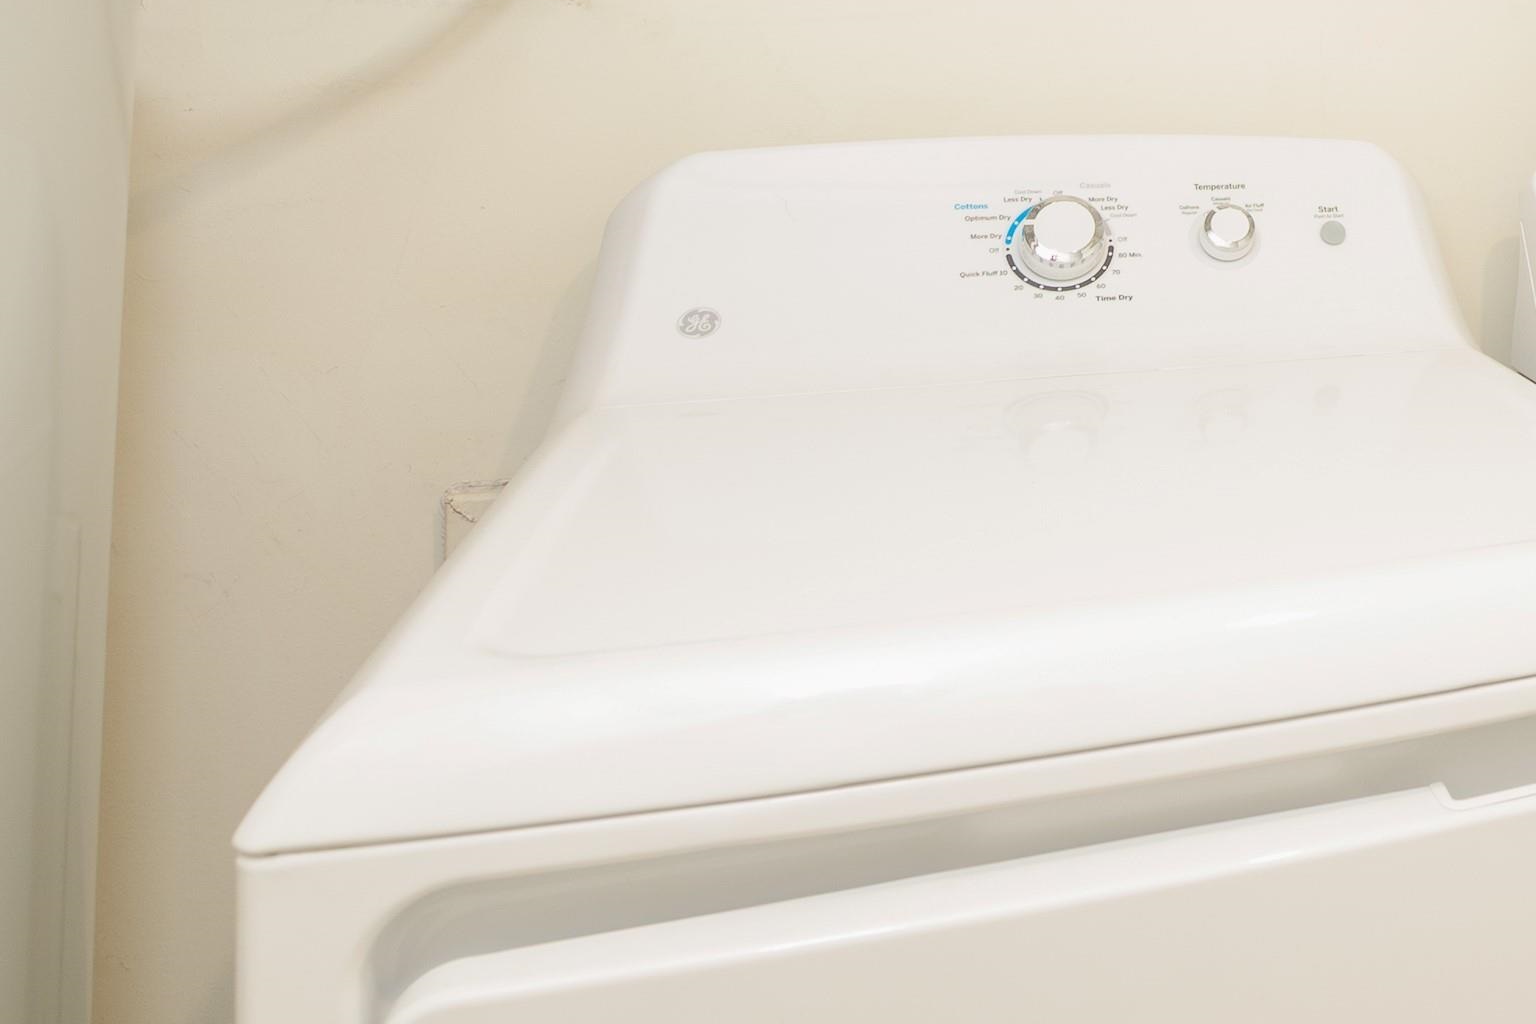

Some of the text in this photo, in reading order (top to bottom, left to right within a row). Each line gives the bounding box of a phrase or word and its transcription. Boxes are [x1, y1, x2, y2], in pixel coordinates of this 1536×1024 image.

[1194, 183, 1246, 192] Temperature
[1318, 205, 1339, 213] Start
[1118, 294, 1133, 302] Dry
